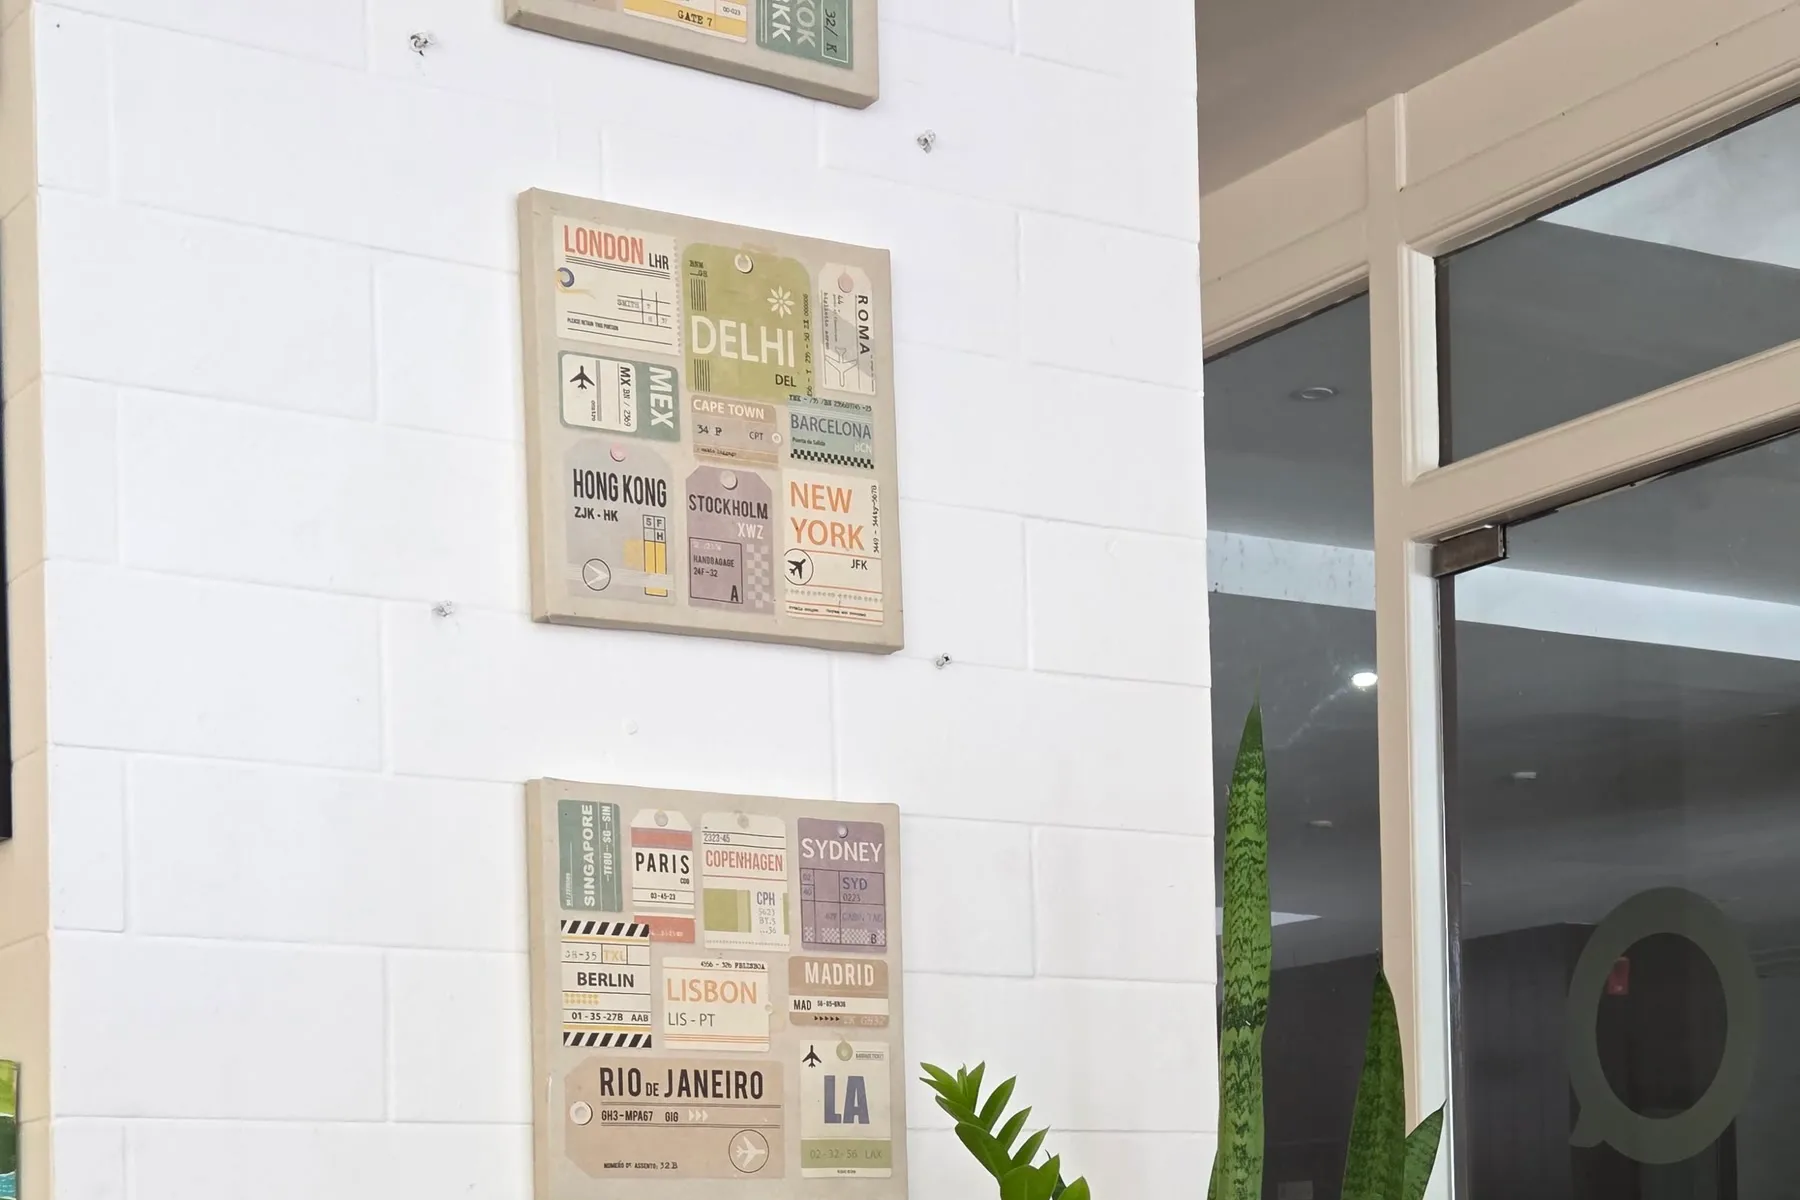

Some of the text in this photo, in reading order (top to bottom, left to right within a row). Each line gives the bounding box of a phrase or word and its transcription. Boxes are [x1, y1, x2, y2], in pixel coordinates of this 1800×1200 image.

[677, 9, 713, 29] GATE 7
[772, 0, 791, 43] KK
[826, 42, 837, 53] K
[564, 225, 669, 270] LONDON LHR
[858, 295, 870, 354] ROMA
[691, 315, 795, 368] DELHI
[620, 367, 631, 386] MX
[775, 374, 797, 387] DEL
[649, 367, 674, 429] MEX
[693, 399, 765, 420] CAPE TOWN
[749, 431, 763, 441] CPT
[791, 414, 872, 440] BARCELONA
[854, 443, 871, 453] BCN
[573, 468, 667, 508] HONG KONG
[790, 481, 852, 513] NEW
[574, 506, 595, 520] ZJK
[603, 509, 619, 522] HK
[689, 494, 768, 520] STOCKHOLM
[656, 519, 662, 527] F
[737, 522, 764, 539] XWZ
[656, 532, 663, 540] H
[790, 517, 865, 551] YORK
[851, 559, 868, 570] JFK
[731, 585, 739, 602] A
[581, 804, 596, 907] SINGAPORE
[801, 837, 882, 863] SYDNEY
[635, 852, 690, 874] PARIS
[705, 850, 783, 872] COPENHAGEN
[842, 876, 868, 890] SYD
[650, 892, 676, 900] 03-45-23
[756, 891, 775, 906] CPH
[870, 934, 877, 944] B
[577, 972, 634, 988] BERLIN
[804, 961, 874, 986] MADRID
[667, 978, 757, 1004] LISBON
[793, 999, 811, 1010] MAD
[631, 1013, 649, 1022] AAB
[668, 1012, 687, 1026] LIS
[699, 1012, 716, 1027] PT
[600, 1067, 764, 1099] RIO DE JANEIRO
[824, 1075, 870, 1124] LA
[601, 1110, 653, 1121] GH3-MPA67
[865, 1149, 882, 1159] LAX
